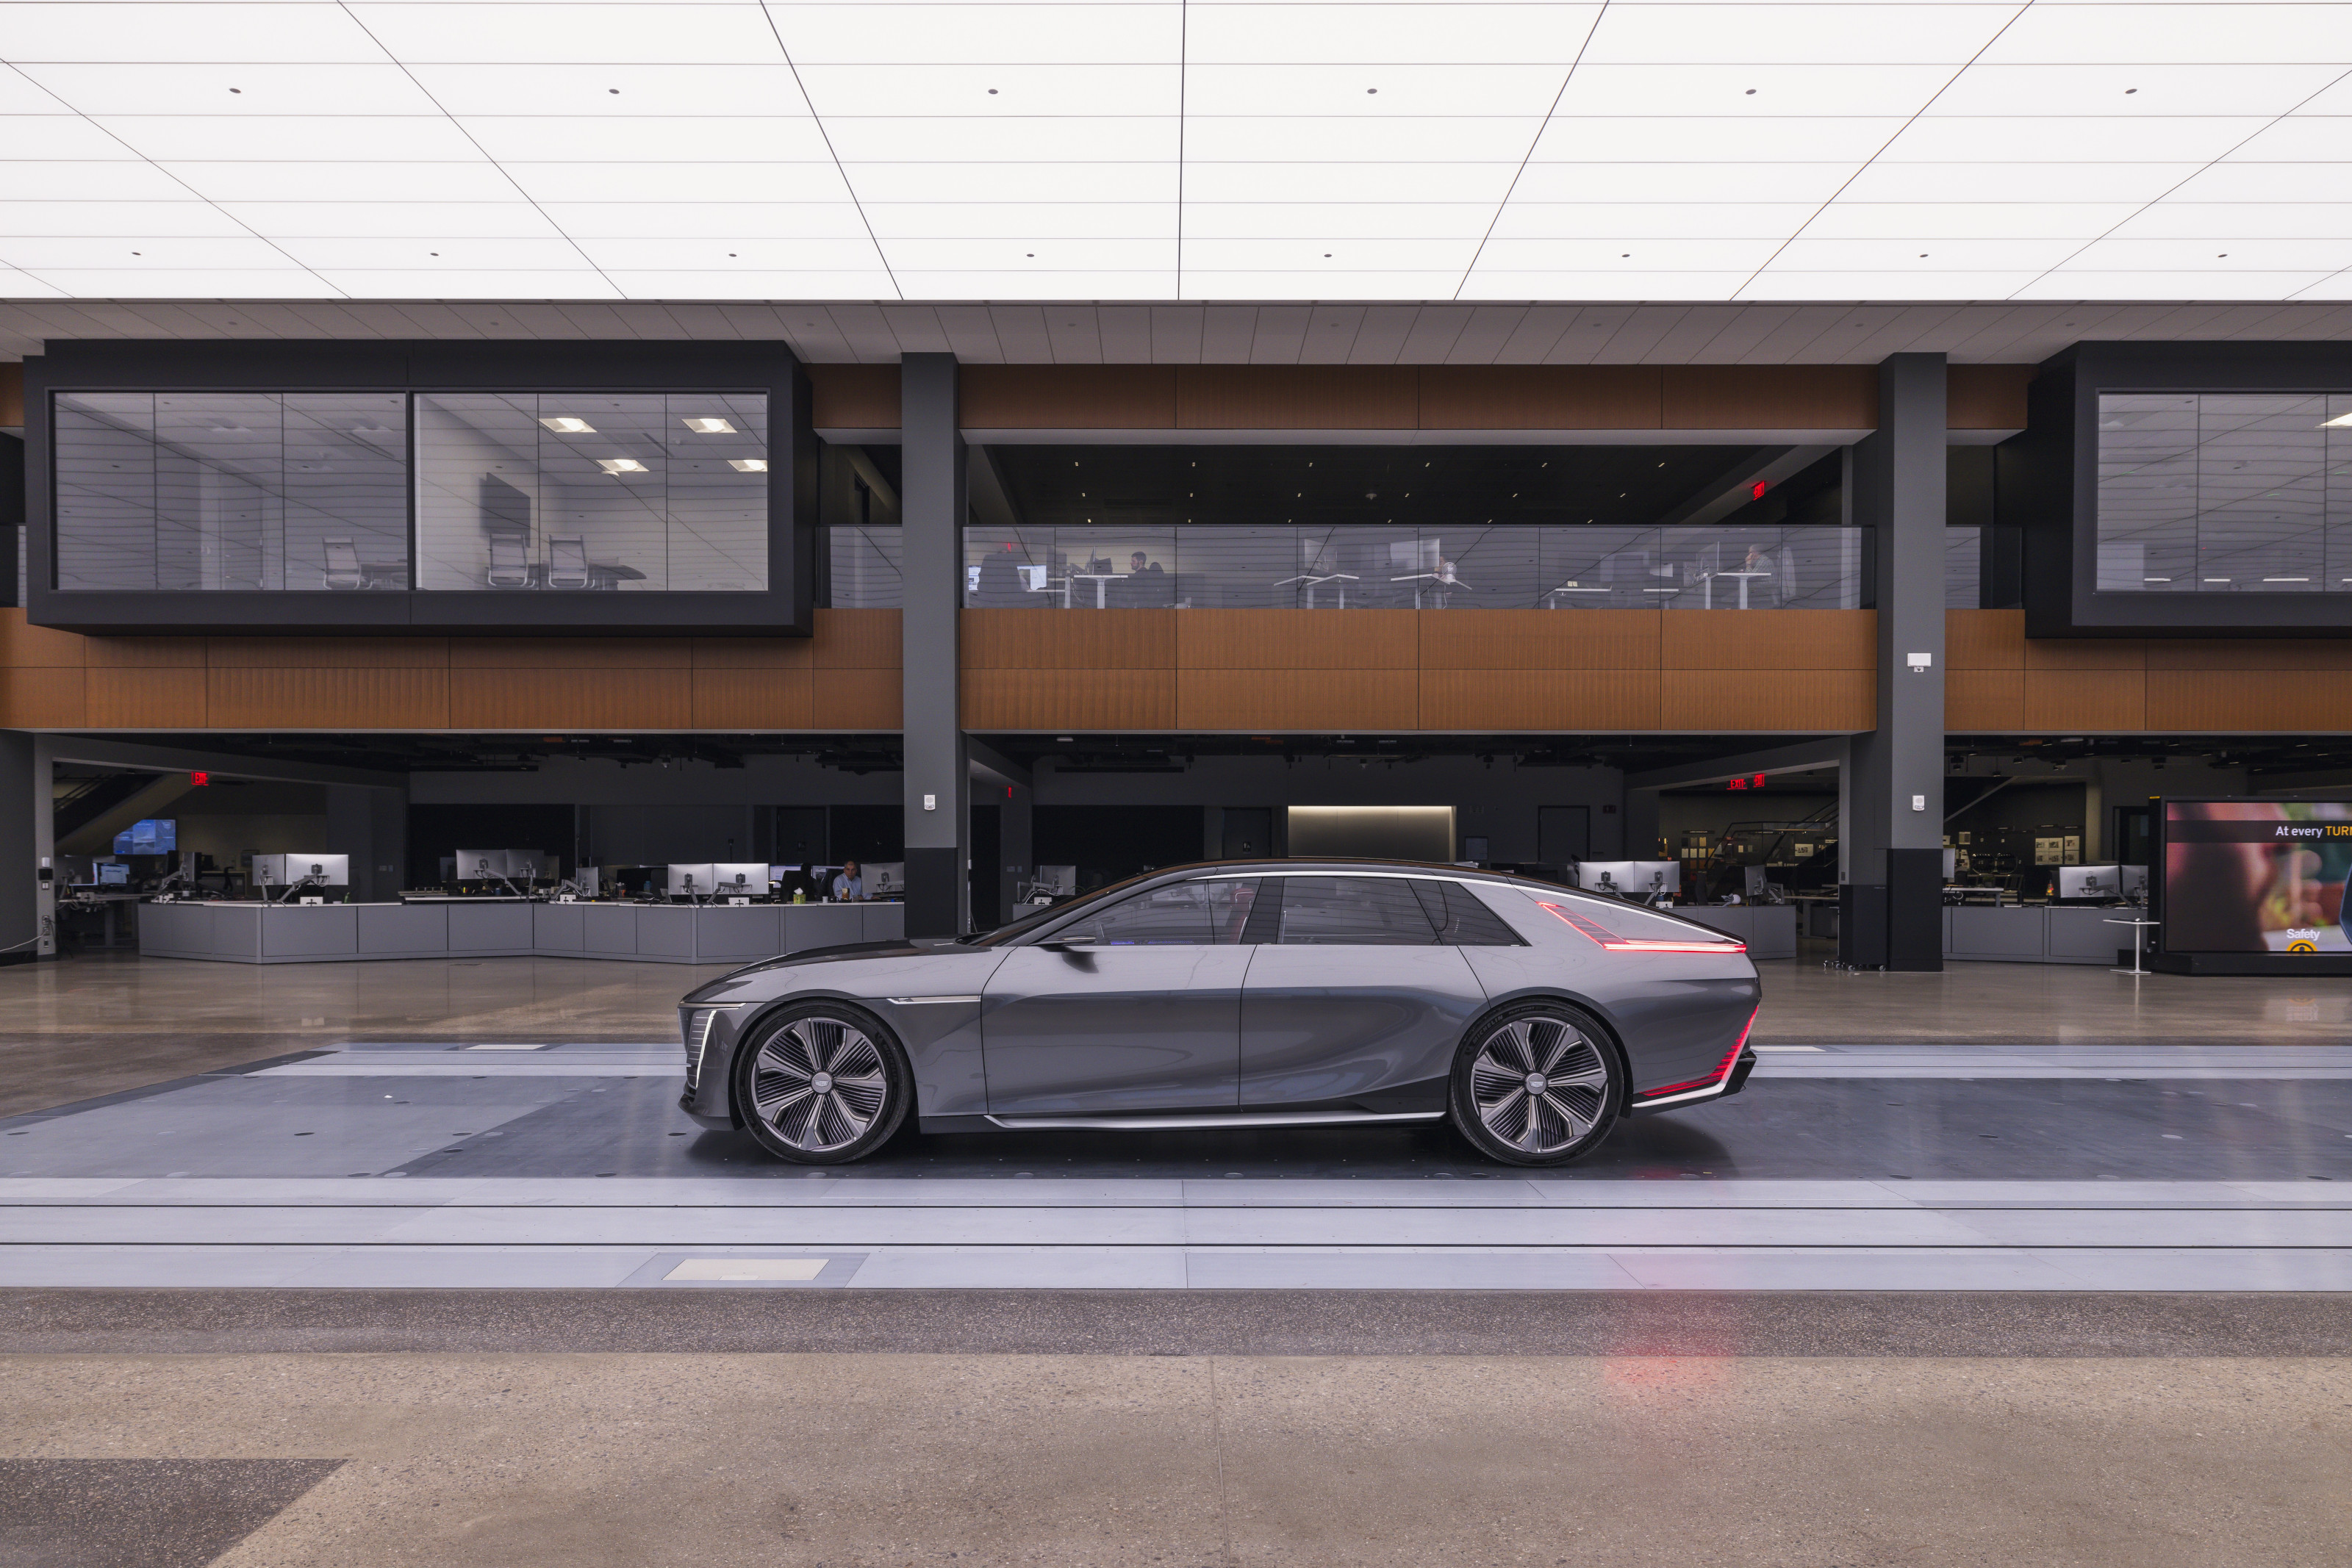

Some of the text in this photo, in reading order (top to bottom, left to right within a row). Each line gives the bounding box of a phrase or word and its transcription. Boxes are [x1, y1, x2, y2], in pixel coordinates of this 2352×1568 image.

[195, 772, 207, 783] EXIT
[1730, 779, 1745, 788] EXIT
[1755, 774, 1763, 785] EXIT
[2276, 826, 2289, 835] At
[2291, 827, 2323, 838] every
[2287, 928, 2320, 941] Safety
[1472, 1015, 1503, 1044] MICHELIN
[883, 1043, 897, 1082] MICHELIN
